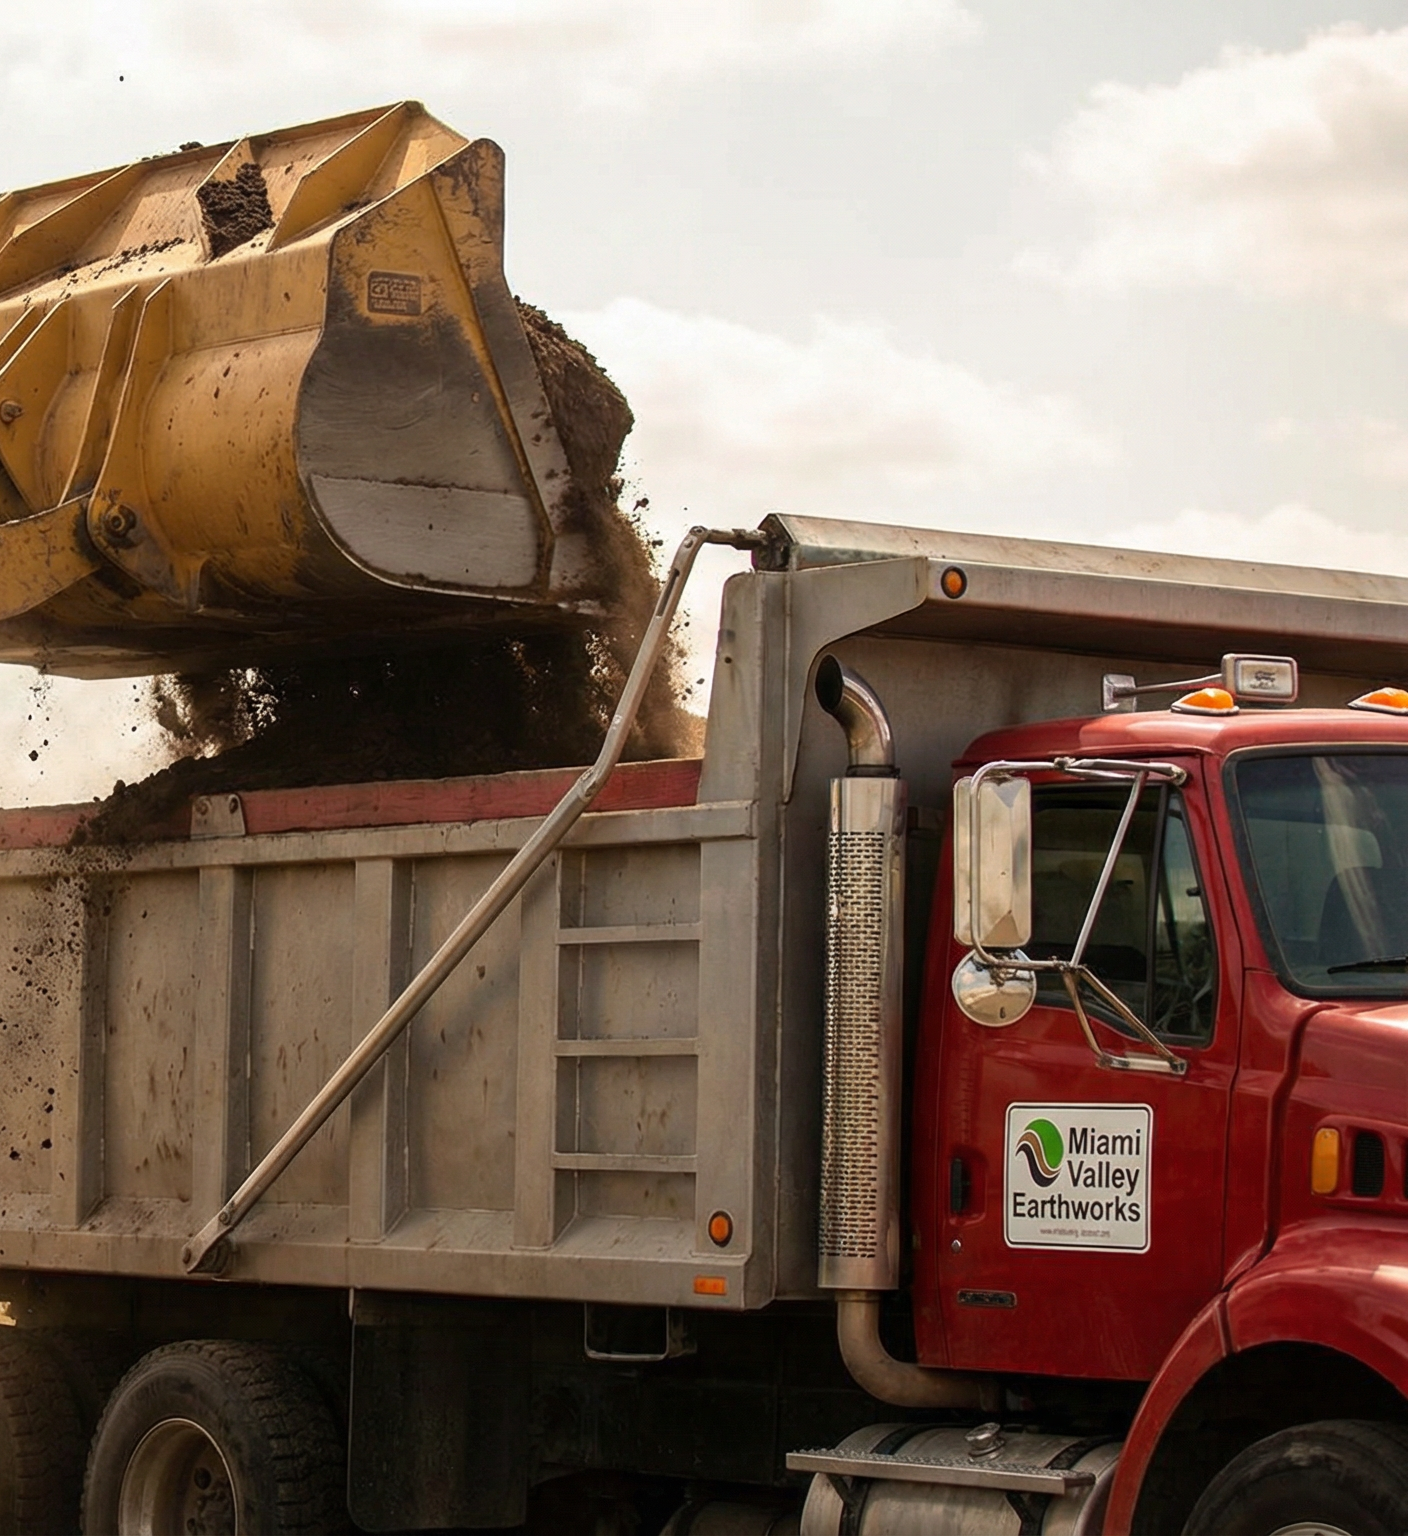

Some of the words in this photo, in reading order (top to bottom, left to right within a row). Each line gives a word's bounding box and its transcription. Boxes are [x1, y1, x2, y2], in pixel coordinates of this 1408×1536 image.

[1068, 1127, 1141, 1156] Miami
[1067, 1160, 1140, 1197] Valley
[1013, 1192, 1141, 1222] Earthworks
